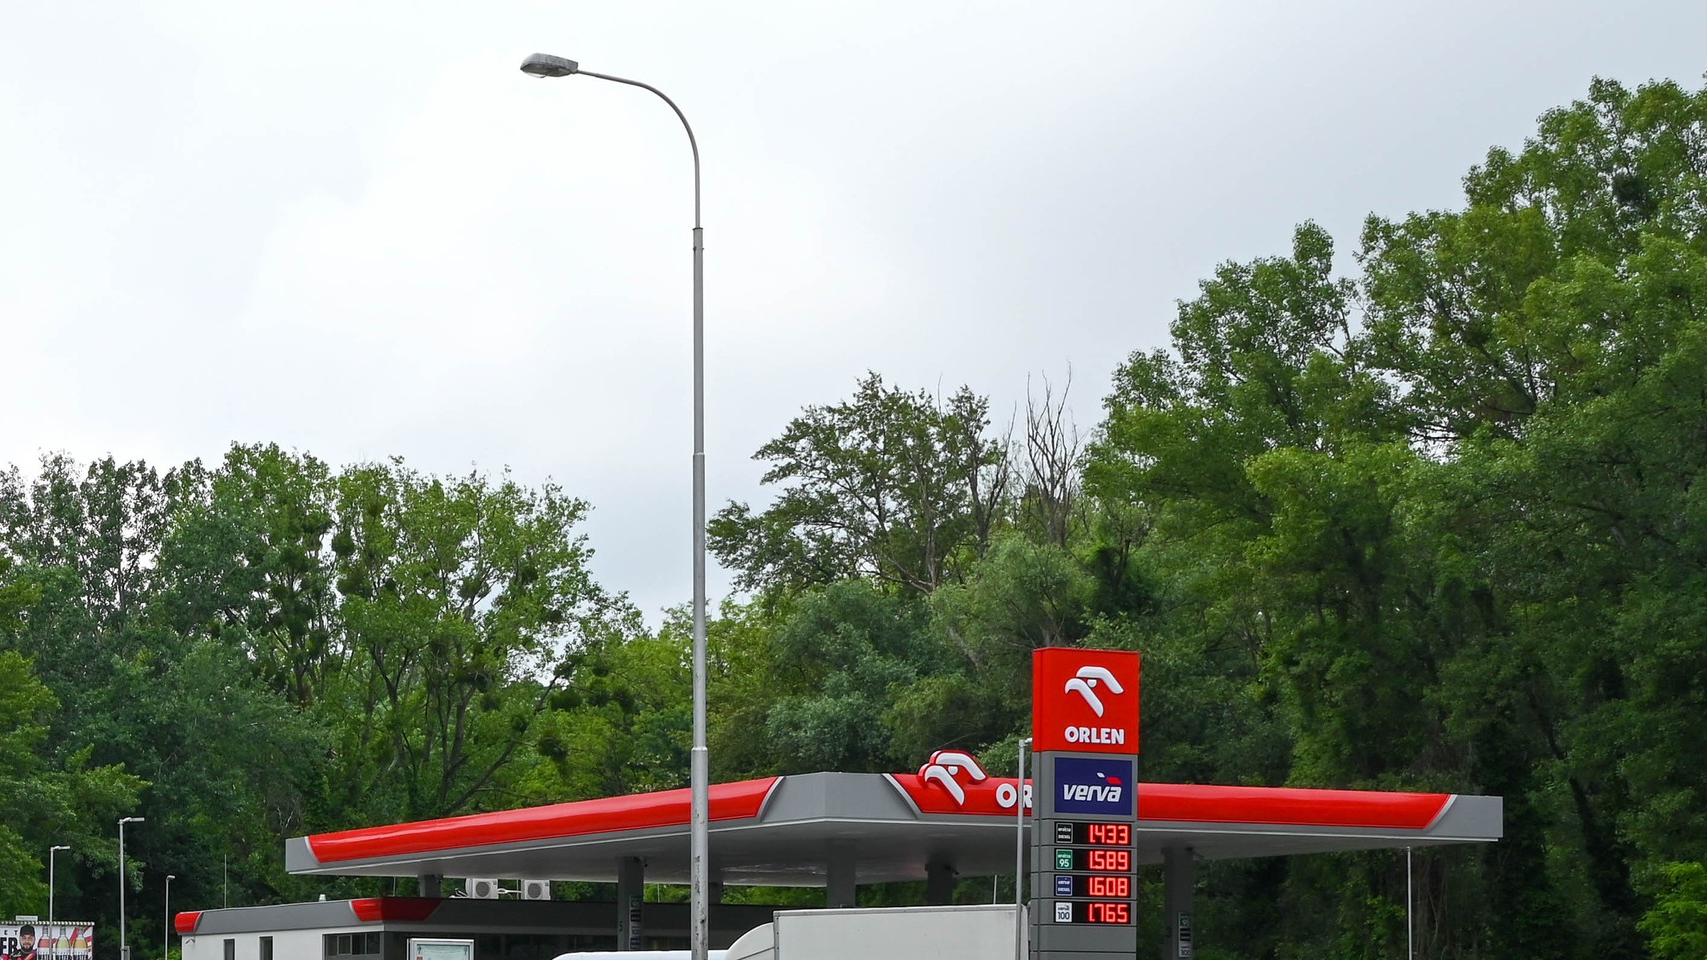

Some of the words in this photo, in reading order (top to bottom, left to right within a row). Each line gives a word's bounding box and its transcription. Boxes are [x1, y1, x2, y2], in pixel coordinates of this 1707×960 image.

[1064, 726, 1125, 745] ORLEN
[1063, 784, 1122, 802] verva
[1059, 859, 1069, 868] 95
[1058, 911, 1070, 920] 100
